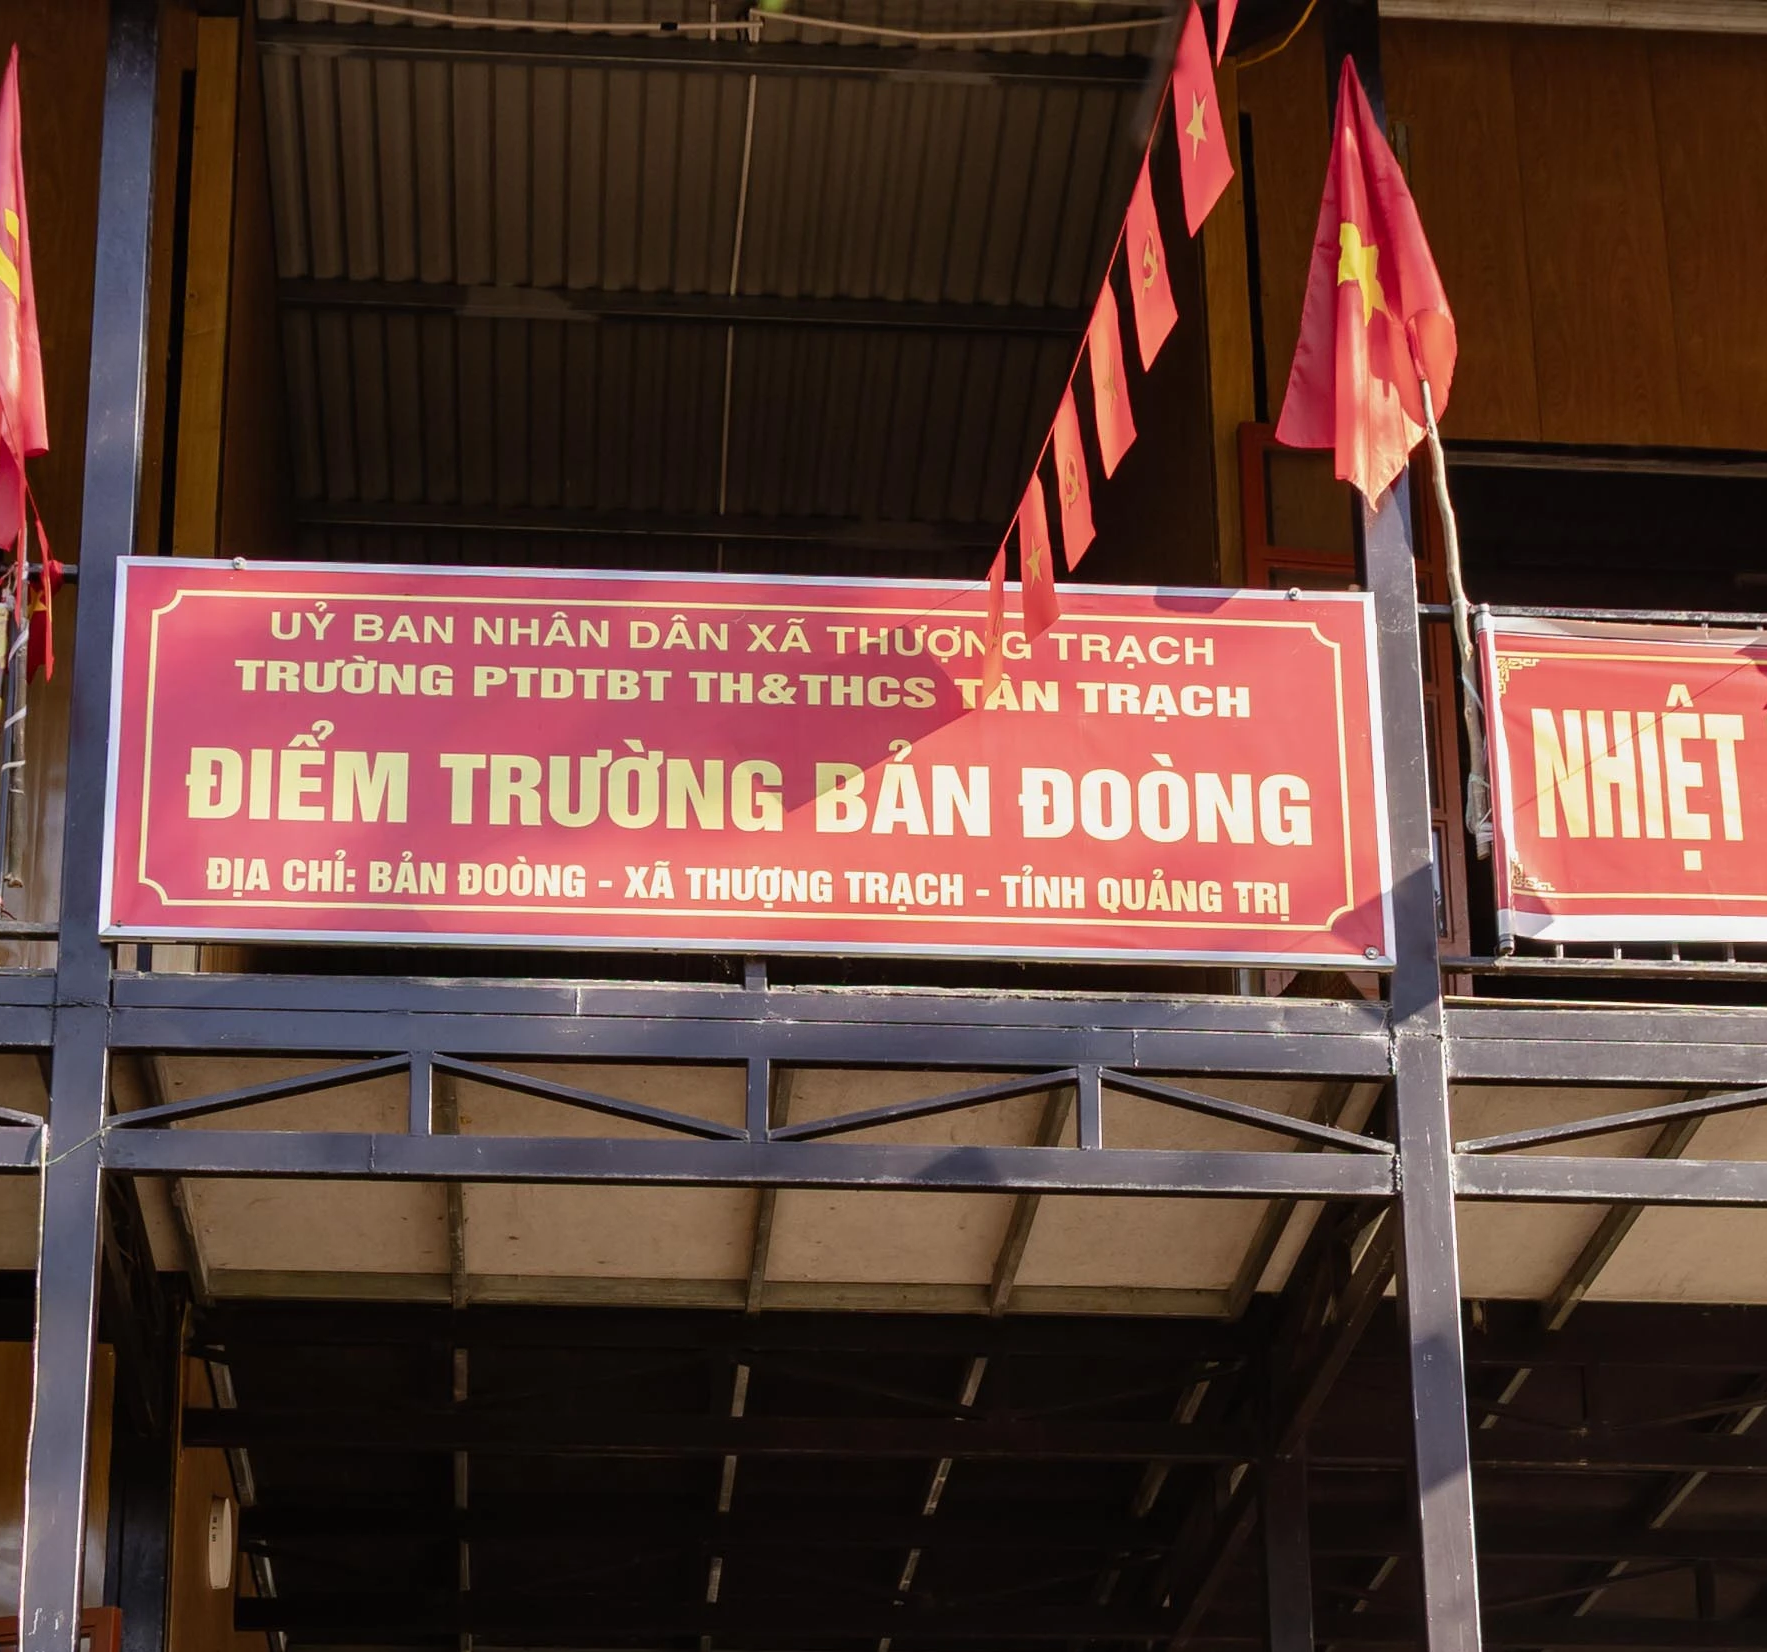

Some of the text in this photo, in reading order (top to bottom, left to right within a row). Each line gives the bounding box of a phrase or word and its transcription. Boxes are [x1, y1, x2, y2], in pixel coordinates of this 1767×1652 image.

[270, 601, 336, 642] UỶ
[354, 614, 454, 645] BAN
[474, 611, 610, 648] NHÂN
[630, 615, 729, 652] DÂN
[746, 618, 811, 654] XÃ
[1049, 633, 1215, 670] TRẠCH
[235, 655, 454, 697] TRƯỜNG
[473, 665, 672, 702] PTDTBT
[689, 670, 937, 709] TH&THCS
[1076, 681, 1251, 722] TRẠCH
[186, 720, 1313, 847] ĐIỂM TRƯỜNG BẢN ĐOÒNG
[1532, 683, 1744, 872] NHIỆT
[206, 849, 1290, 921] ĐỊA CHỈ: BẢN ĐOÒNG - XÃ THƯỢNG TRẠCH - TỈNH QUẢNG TRỊ
